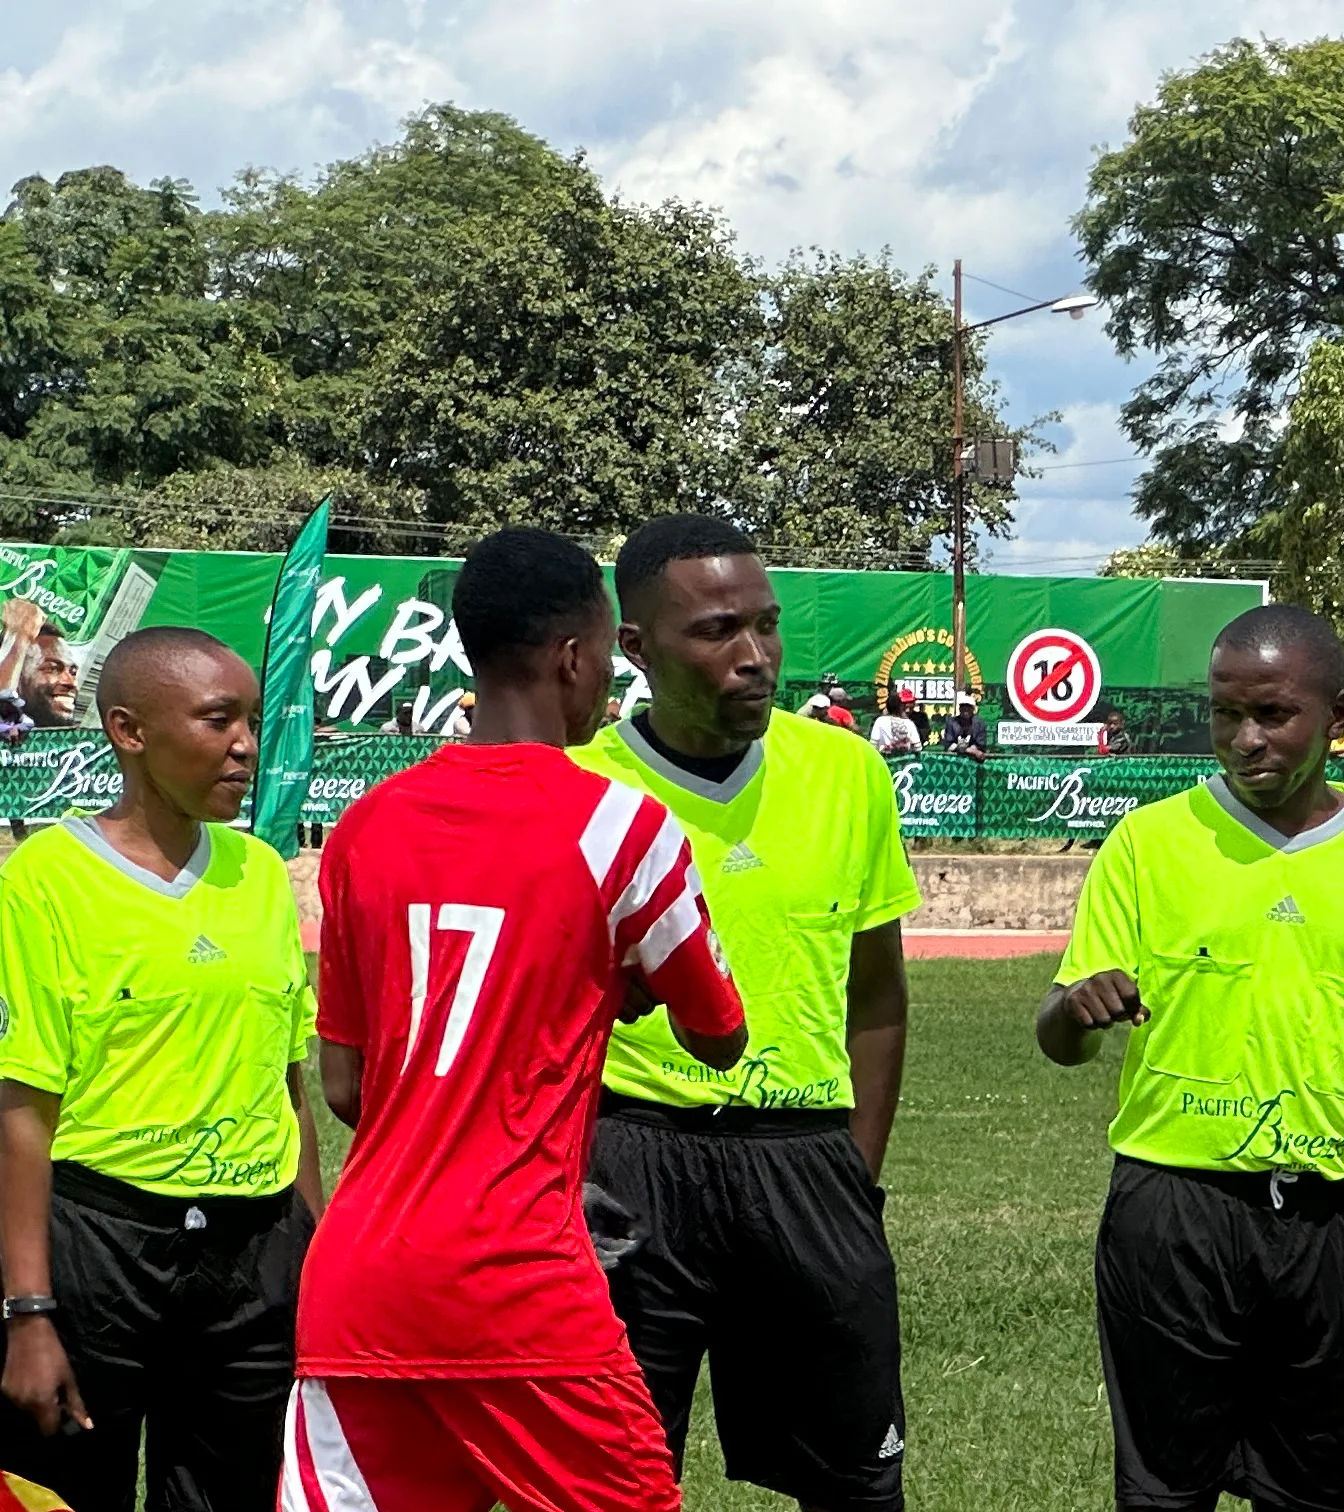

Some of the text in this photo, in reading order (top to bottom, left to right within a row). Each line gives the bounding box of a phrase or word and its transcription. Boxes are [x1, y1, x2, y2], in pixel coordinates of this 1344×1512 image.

[0, 559, 86, 624] Breeze
[926, 680, 955, 699] BES
[0, 749, 59, 768] PACIFIC
[308, 778, 366, 799] eeze
[892, 763, 973, 814] Breeze
[1007, 768, 1138, 822] PACIFIC Breeze
[721, 858, 764, 873] adidas
[1265, 912, 1307, 925] adidas
[401, 903, 506, 1077] 17
[725, 1046, 839, 1109] Breeze
[1182, 1092, 1253, 1119] PACIFIC
